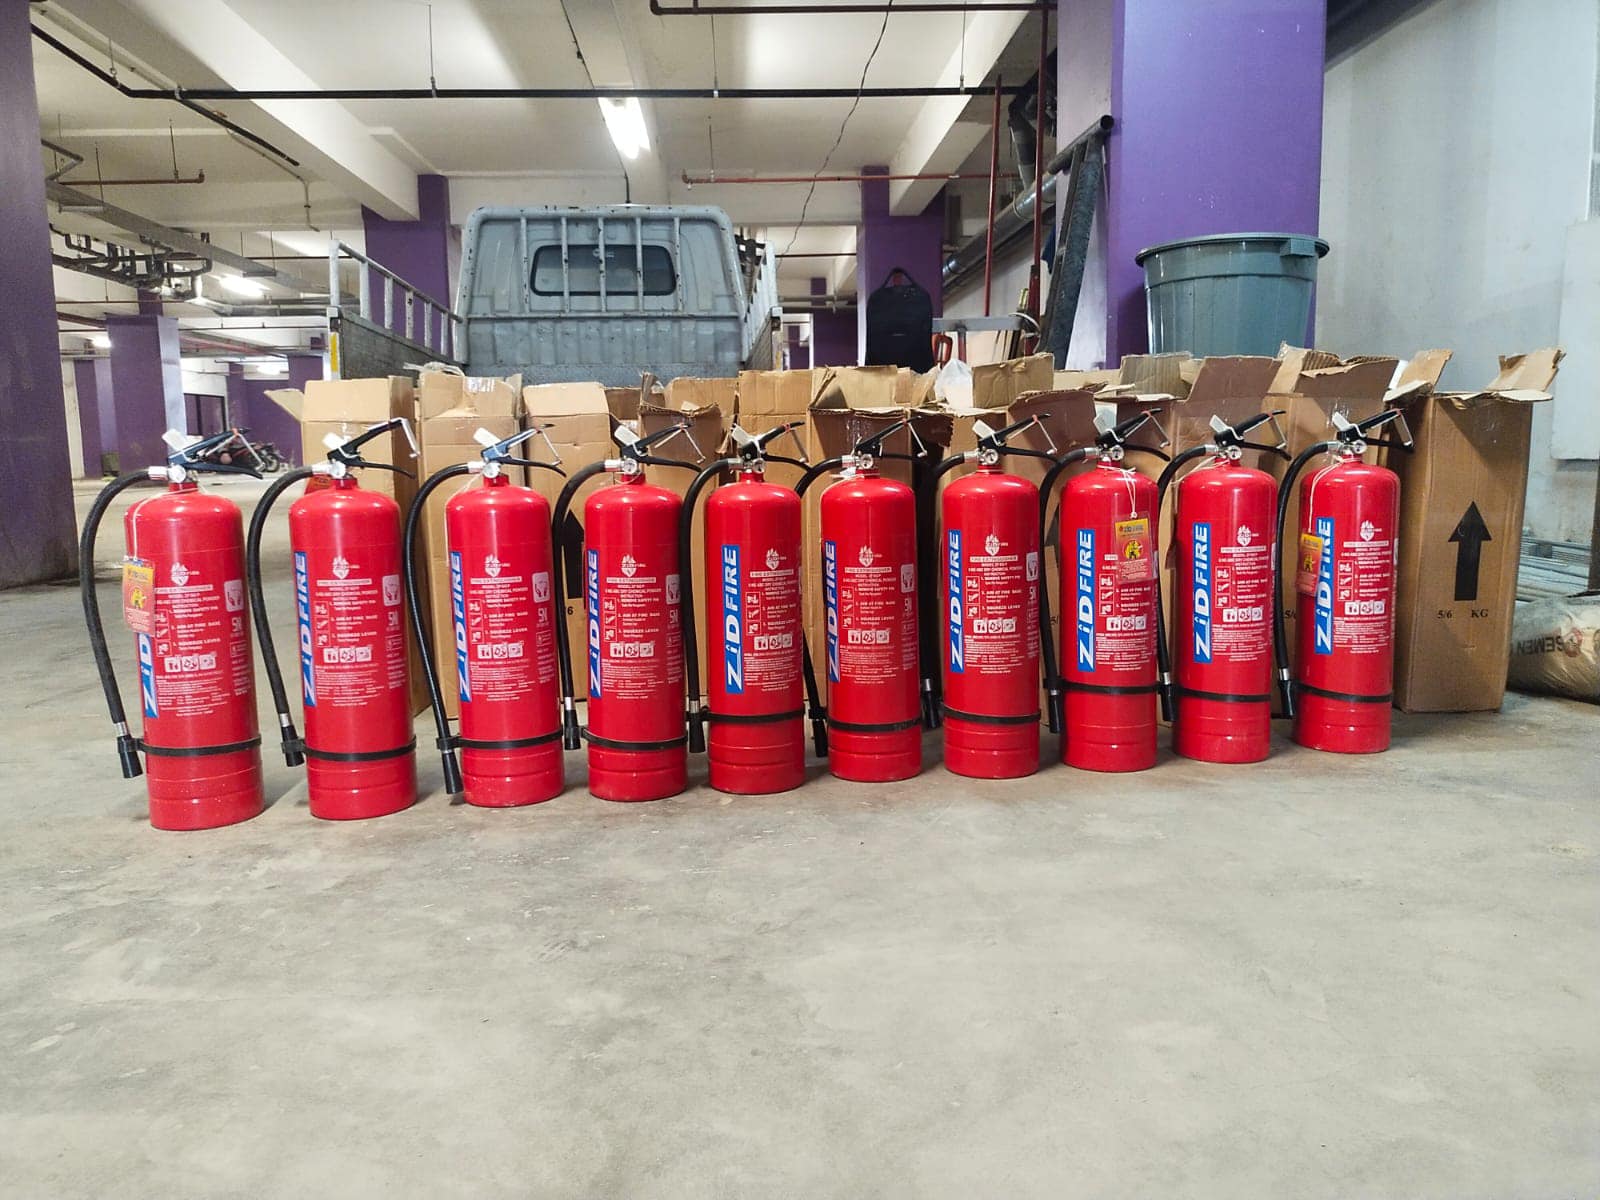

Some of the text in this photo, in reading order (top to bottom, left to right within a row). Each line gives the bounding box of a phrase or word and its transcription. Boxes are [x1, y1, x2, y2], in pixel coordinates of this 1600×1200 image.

[451, 551, 464, 619] FIRE
[588, 550, 599, 616] FIRE
[724, 547, 739, 611] FIRE
[825, 542, 836, 604] FIRE
[949, 531, 960, 593] FIRE
[1078, 531, 1091, 593] FIRE
[1194, 525, 1208, 585] FIRE
[295, 552, 309, 621] FIRE
[1471, 608, 1489, 618] KG
